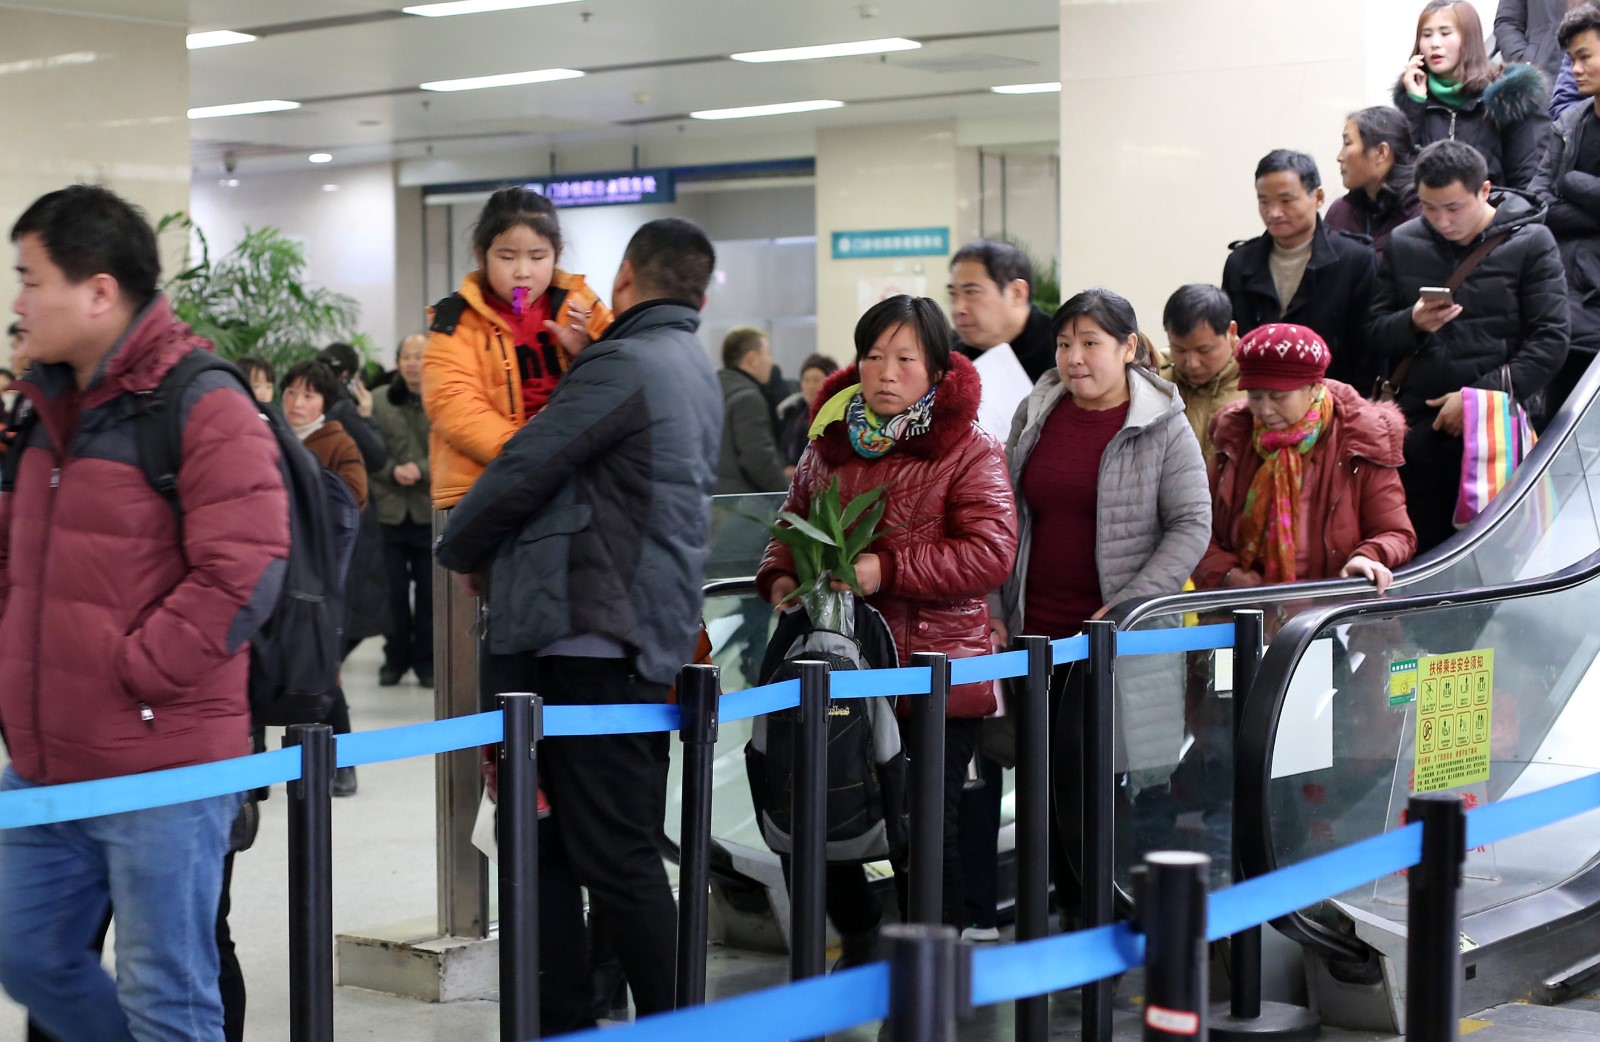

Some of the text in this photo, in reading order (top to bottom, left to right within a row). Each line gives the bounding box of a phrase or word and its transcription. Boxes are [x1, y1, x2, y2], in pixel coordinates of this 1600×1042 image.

[1429, 655, 1484, 676] 扶梯乘坐安全须知
